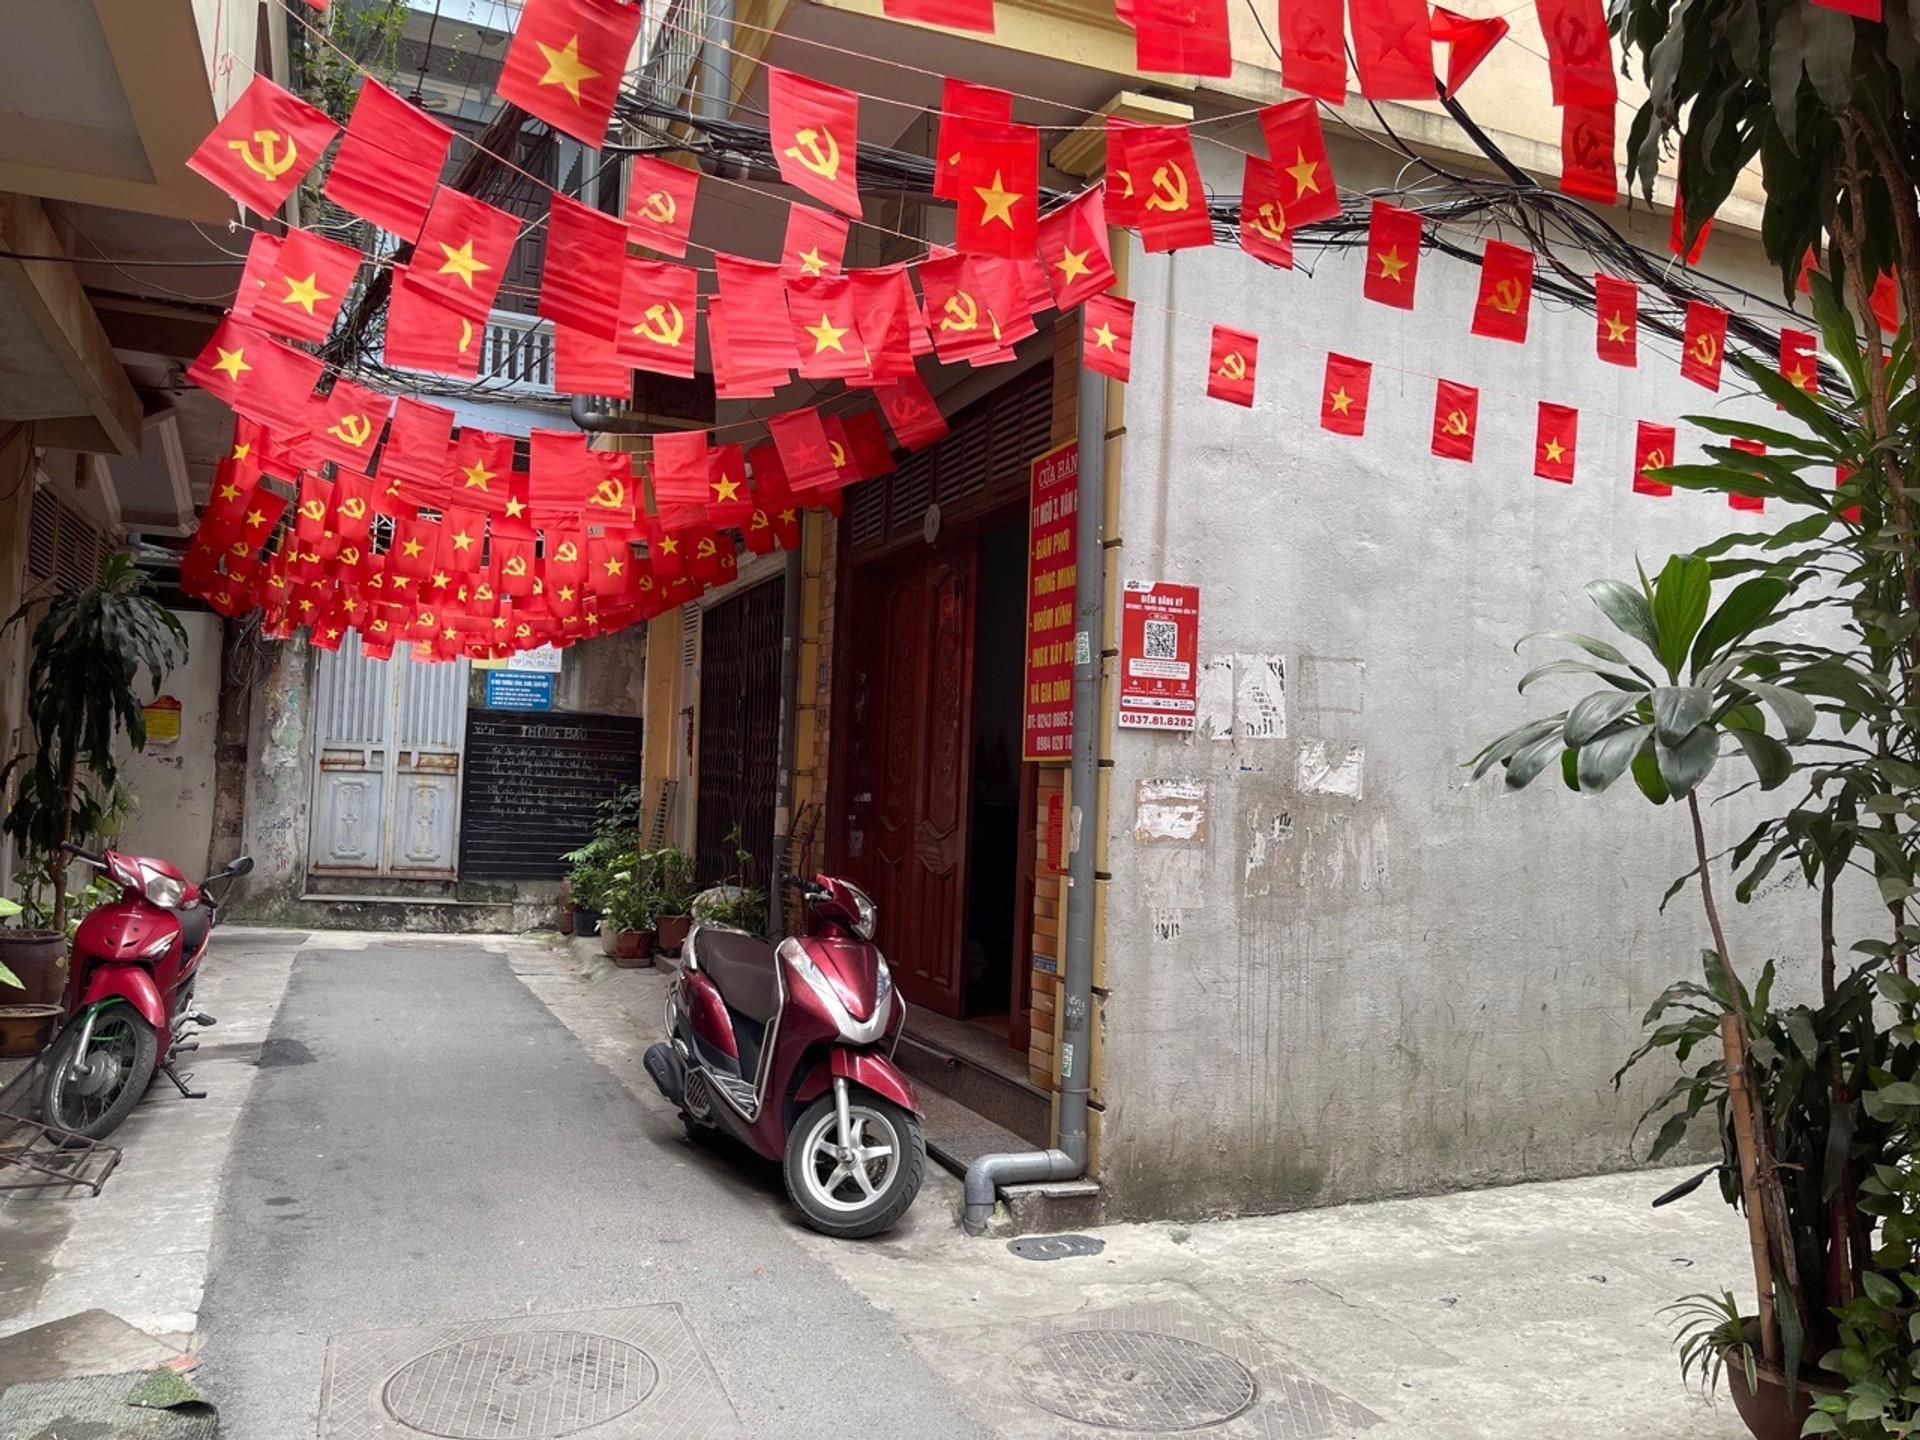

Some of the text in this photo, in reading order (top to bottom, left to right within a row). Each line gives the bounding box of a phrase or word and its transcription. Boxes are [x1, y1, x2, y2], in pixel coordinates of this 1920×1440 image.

[1038, 459, 1056, 488] CỬA
[1034, 569, 1056, 597] THÔNG
[1033, 601, 1072, 633] NHÔM KÍNH
[1040, 682, 1052, 704] GIA
[1053, 676, 1071, 702] ĐÌNH
[520, 723, 559, 740] THÔNG
[1122, 714, 1193, 728] 0837.81.8282
